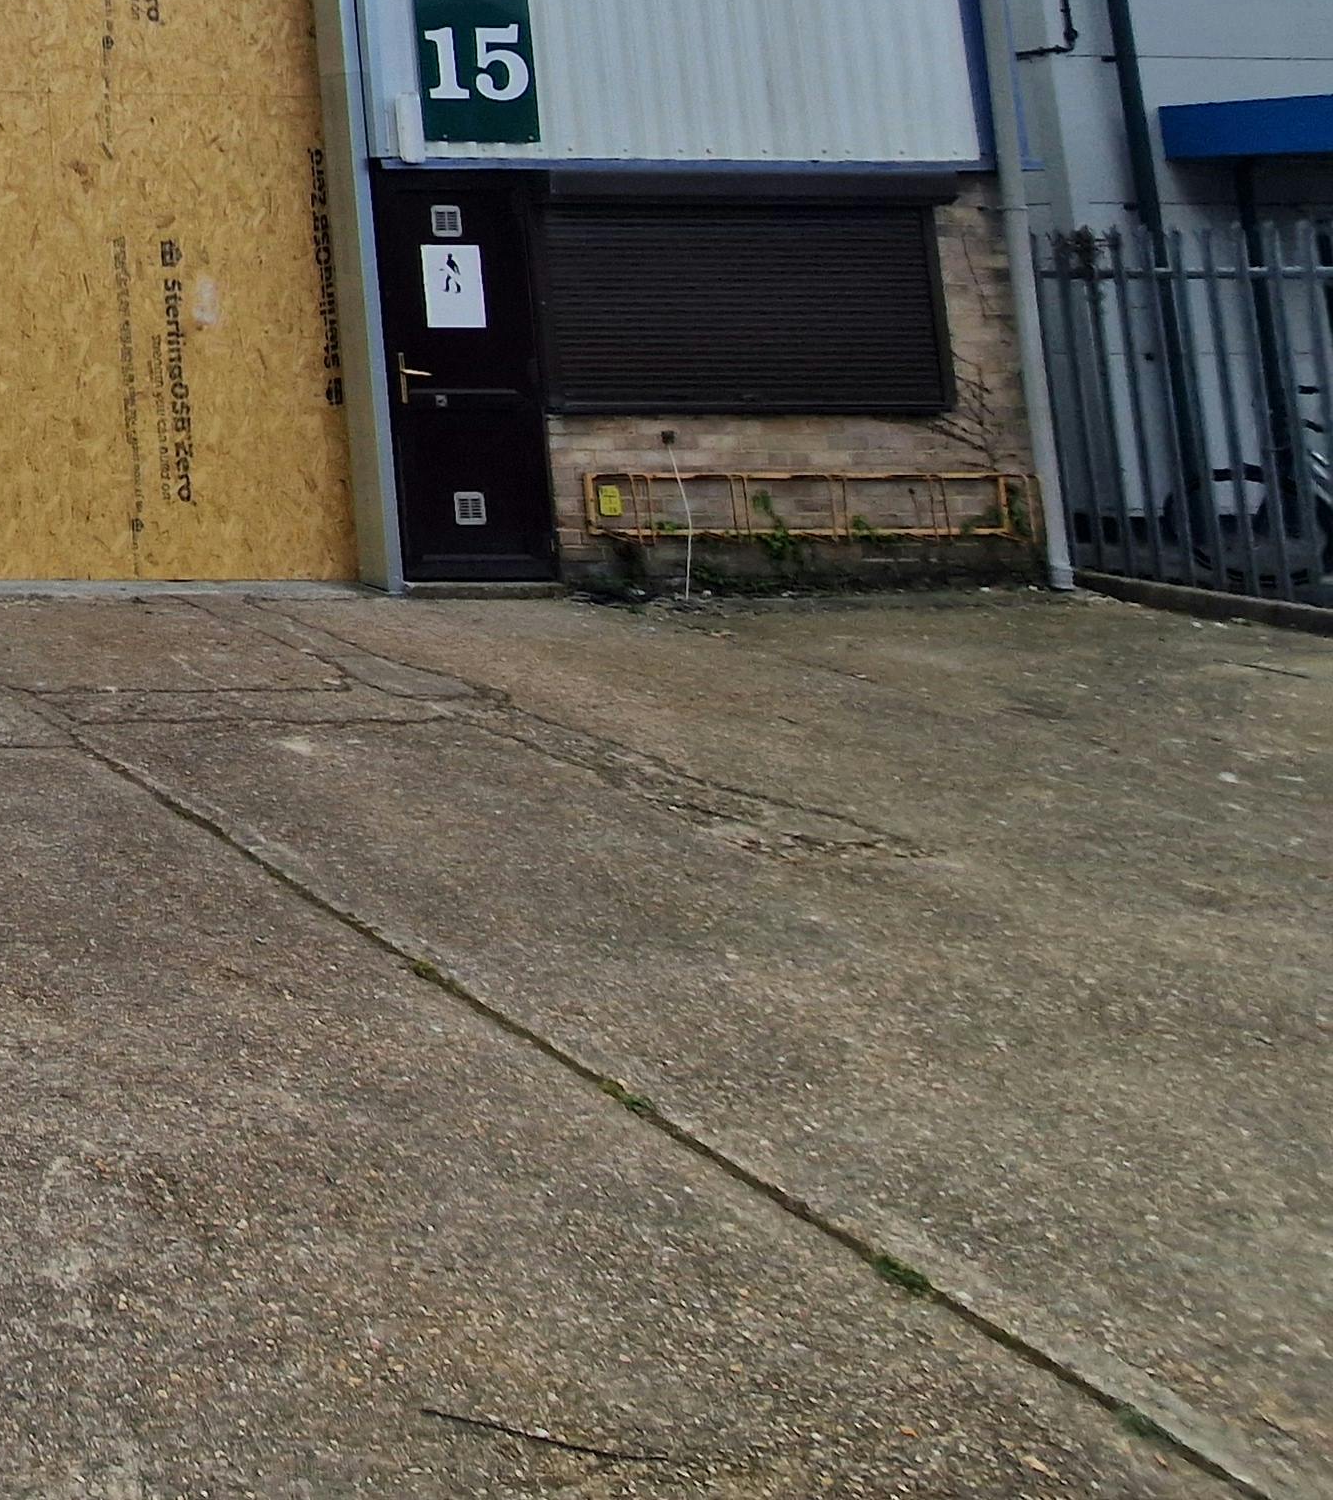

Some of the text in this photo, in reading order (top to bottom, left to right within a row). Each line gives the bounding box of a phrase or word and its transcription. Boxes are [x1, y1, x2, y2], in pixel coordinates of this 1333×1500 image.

[424, 23, 529, 101] 15
[310, 148, 327, 207] Zero
[174, 441, 194, 504] Zero
